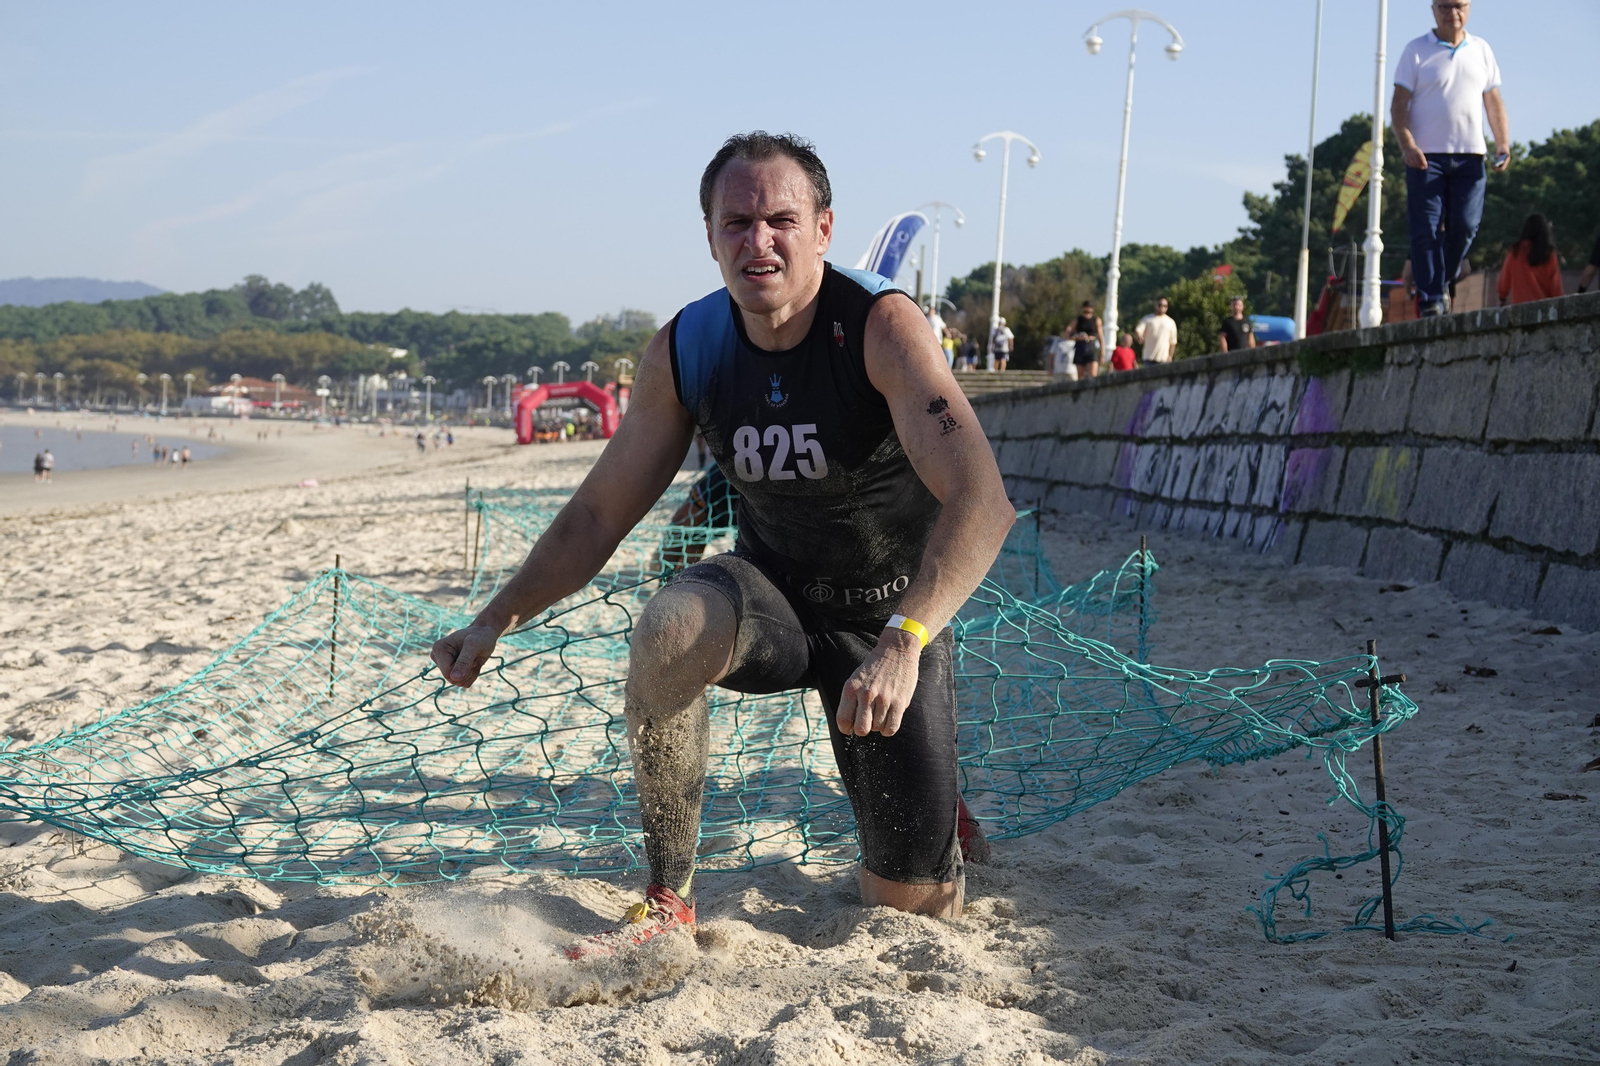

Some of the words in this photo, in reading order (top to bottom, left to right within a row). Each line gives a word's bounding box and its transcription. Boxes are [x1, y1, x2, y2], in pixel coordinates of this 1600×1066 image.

[939, 416, 957, 430] 28
[733, 424, 828, 482] 825
[844, 575, 909, 605] Faro
